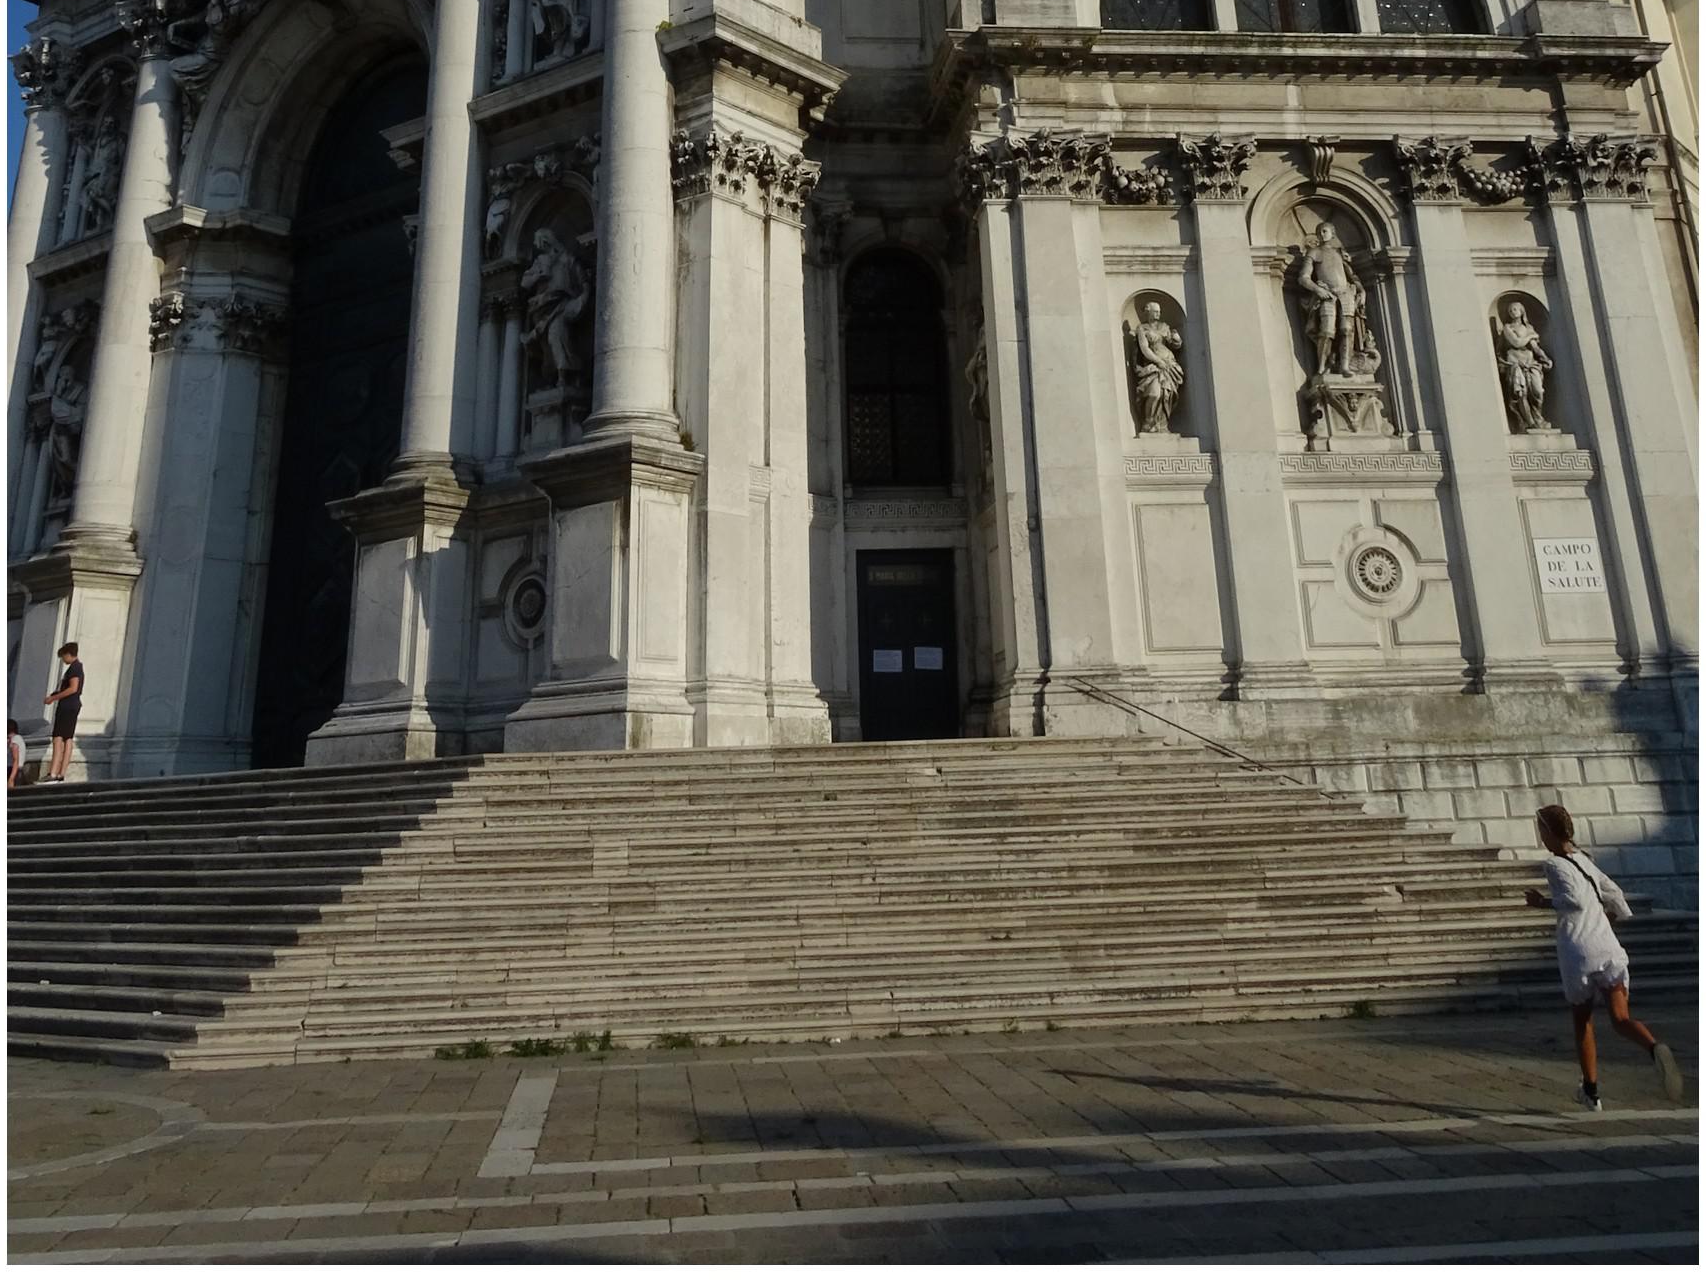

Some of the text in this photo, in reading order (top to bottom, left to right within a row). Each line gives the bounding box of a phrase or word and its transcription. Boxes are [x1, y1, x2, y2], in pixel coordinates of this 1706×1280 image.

[1542, 543, 1592, 556] CAMPO
[1547, 560, 1594, 572] DE LA
[1547, 576, 1603, 588] SALUTE
